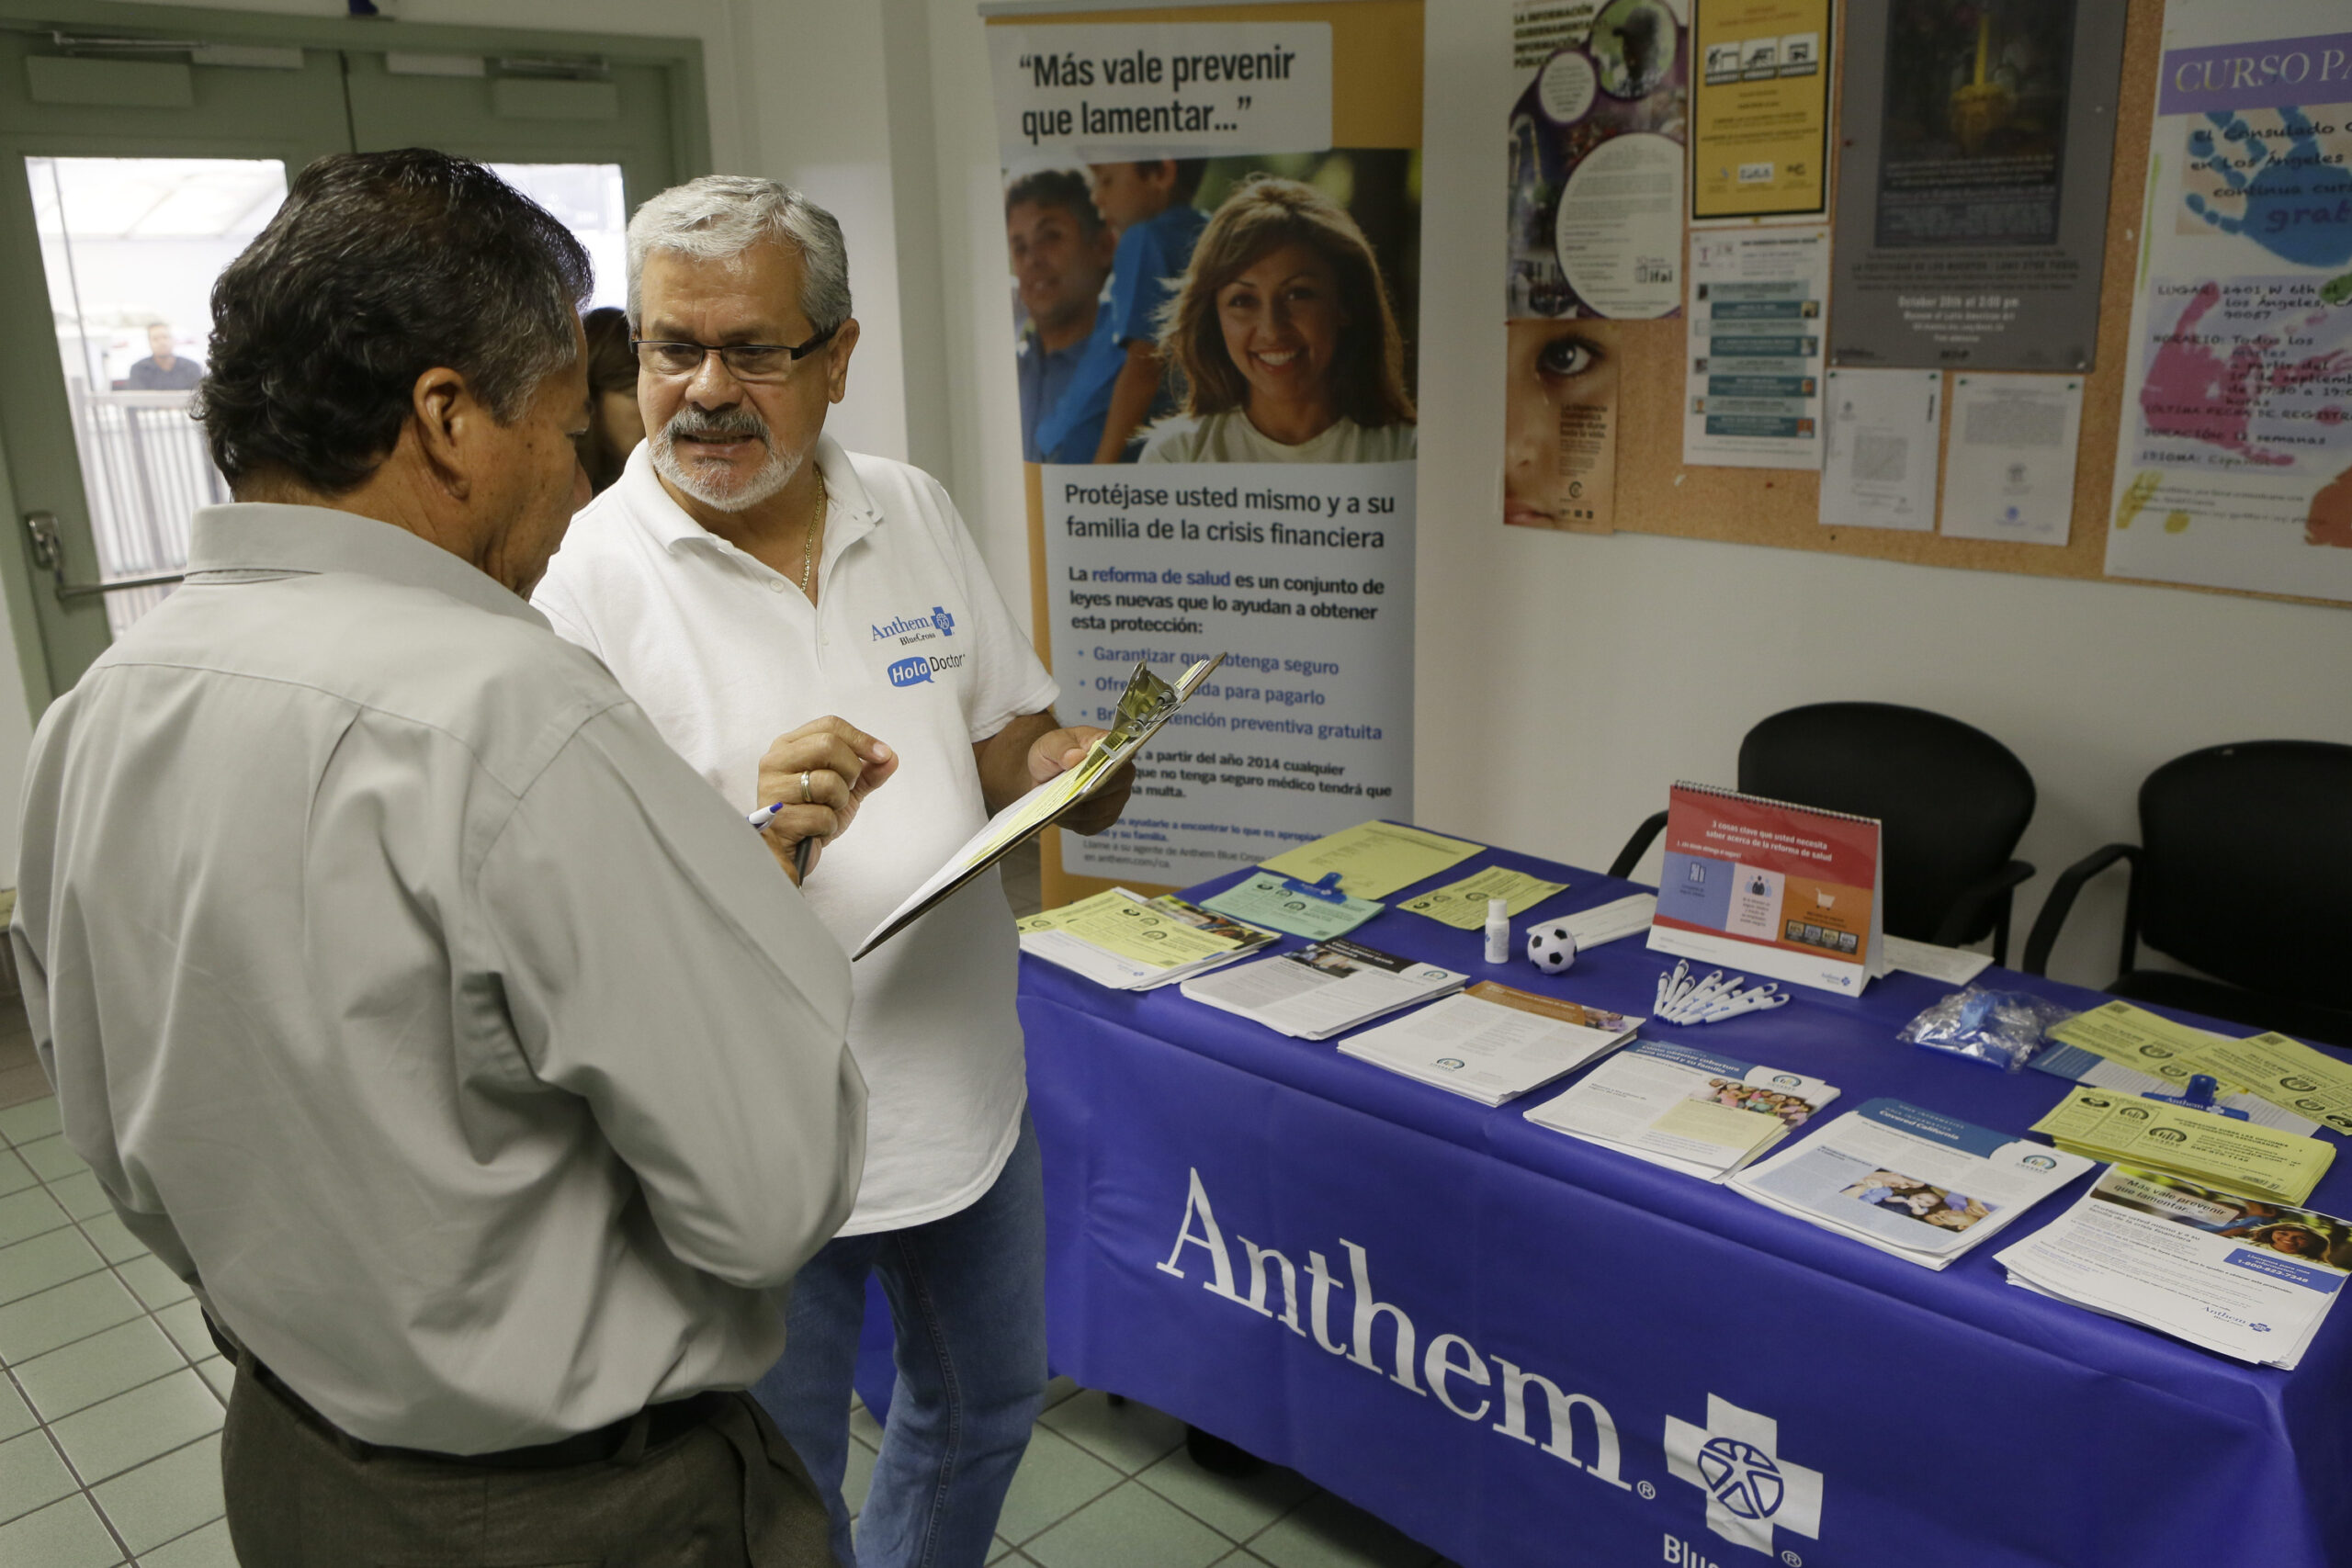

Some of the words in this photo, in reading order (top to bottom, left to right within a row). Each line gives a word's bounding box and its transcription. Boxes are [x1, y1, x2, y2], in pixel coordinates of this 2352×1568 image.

[1020, 51, 1094, 87] “Más
[1102, 50, 1162, 85] vale
[1172, 45, 1295, 92] prevenir
[2175, 51, 2308, 92] CURSO
[1023, 109, 1073, 145] que
[1066, 483, 1169, 510] Protéjase
[1176, 487, 1238, 507] usted
[1246, 489, 1321, 513] mismo
[1327, 496, 1340, 517] y
[1347, 497, 1361, 513] a
[1368, 495, 1395, 513] su
[1066, 514, 1140, 538] familia
[1148, 518, 1174, 540] de
[1182, 519, 1200, 540] la
[1207, 521, 1265, 544] crisis
[1271, 522, 1385, 548] financiera
[1069, 566, 1088, 581] La
[1092, 567, 1158, 583] reforma
[1162, 569, 1182, 585] de
[1187, 570, 1230, 587] salud
[1235, 575, 1255, 589] es
[1259, 576, 1279, 590] un
[1283, 577, 1359, 596] conjunto
[1363, 578, 1385, 595] de
[1069, 590, 1112, 609] leyes
[1115, 593, 1174, 609] nuevas
[1178, 596, 1209, 613] que
[1213, 594, 1227, 611] lo
[1232, 598, 1292, 616] ayudan
[1296, 604, 1306, 616] a
[1310, 602, 1379, 620] obtener
[871, 615, 931, 641] Anthem
[1071, 615, 1106, 629] esta
[1111, 616, 1204, 634] protección:
[1093, 646, 1175, 664] Garantizar
[1283, 659, 1340, 677] seguro
[1225, 685, 1261, 701] para
[1264, 689, 1326, 706] pagarlo
[1169, 711, 1227, 728] tención
[1231, 716, 1314, 736] preventiva
[1317, 724, 1383, 740] gratuita
[1145, 751, 1153, 761] a
[1156, 750, 1193, 764] partir
[1195, 751, 1216, 764] del
[1219, 754, 1244, 767] año
[1247, 756, 1280, 770] 2014
[1283, 761, 1346, 777] cualquier
[1146, 785, 1187, 798] multa.
[1160, 770, 1177, 780] no
[1180, 769, 1216, 785] tenga
[1220, 773, 1264, 788] seguro
[1267, 776, 1316, 792] médico
[1318, 781, 1363, 796] tendrá
[1366, 786, 1393, 800] que
[1706, 829, 1726, 840] saber
[1726, 833, 1751, 846] acerca
[1752, 839, 1762, 848] de
[1762, 840, 1770, 850] la
[1770, 842, 1801, 855] reforma
[1801, 848, 1811, 858] de
[1812, 851, 1833, 863] salud
[1718, 821, 1739, 833] cosas
[1740, 825, 1758, 837] clave
[1759, 829, 1774, 841] que
[1774, 831, 1795, 844] usted
[1796, 837, 1828, 851] necesita
[2113, 1184, 2135, 1198] que
[2153, 1187, 2177, 1201] vale
[2176, 1196, 2227, 1216] prevenir
[1156, 1167, 1634, 1493] Anthem
[2203, 1305, 2247, 1325] Anthem
[1664, 1533, 1721, 1568] Blu
